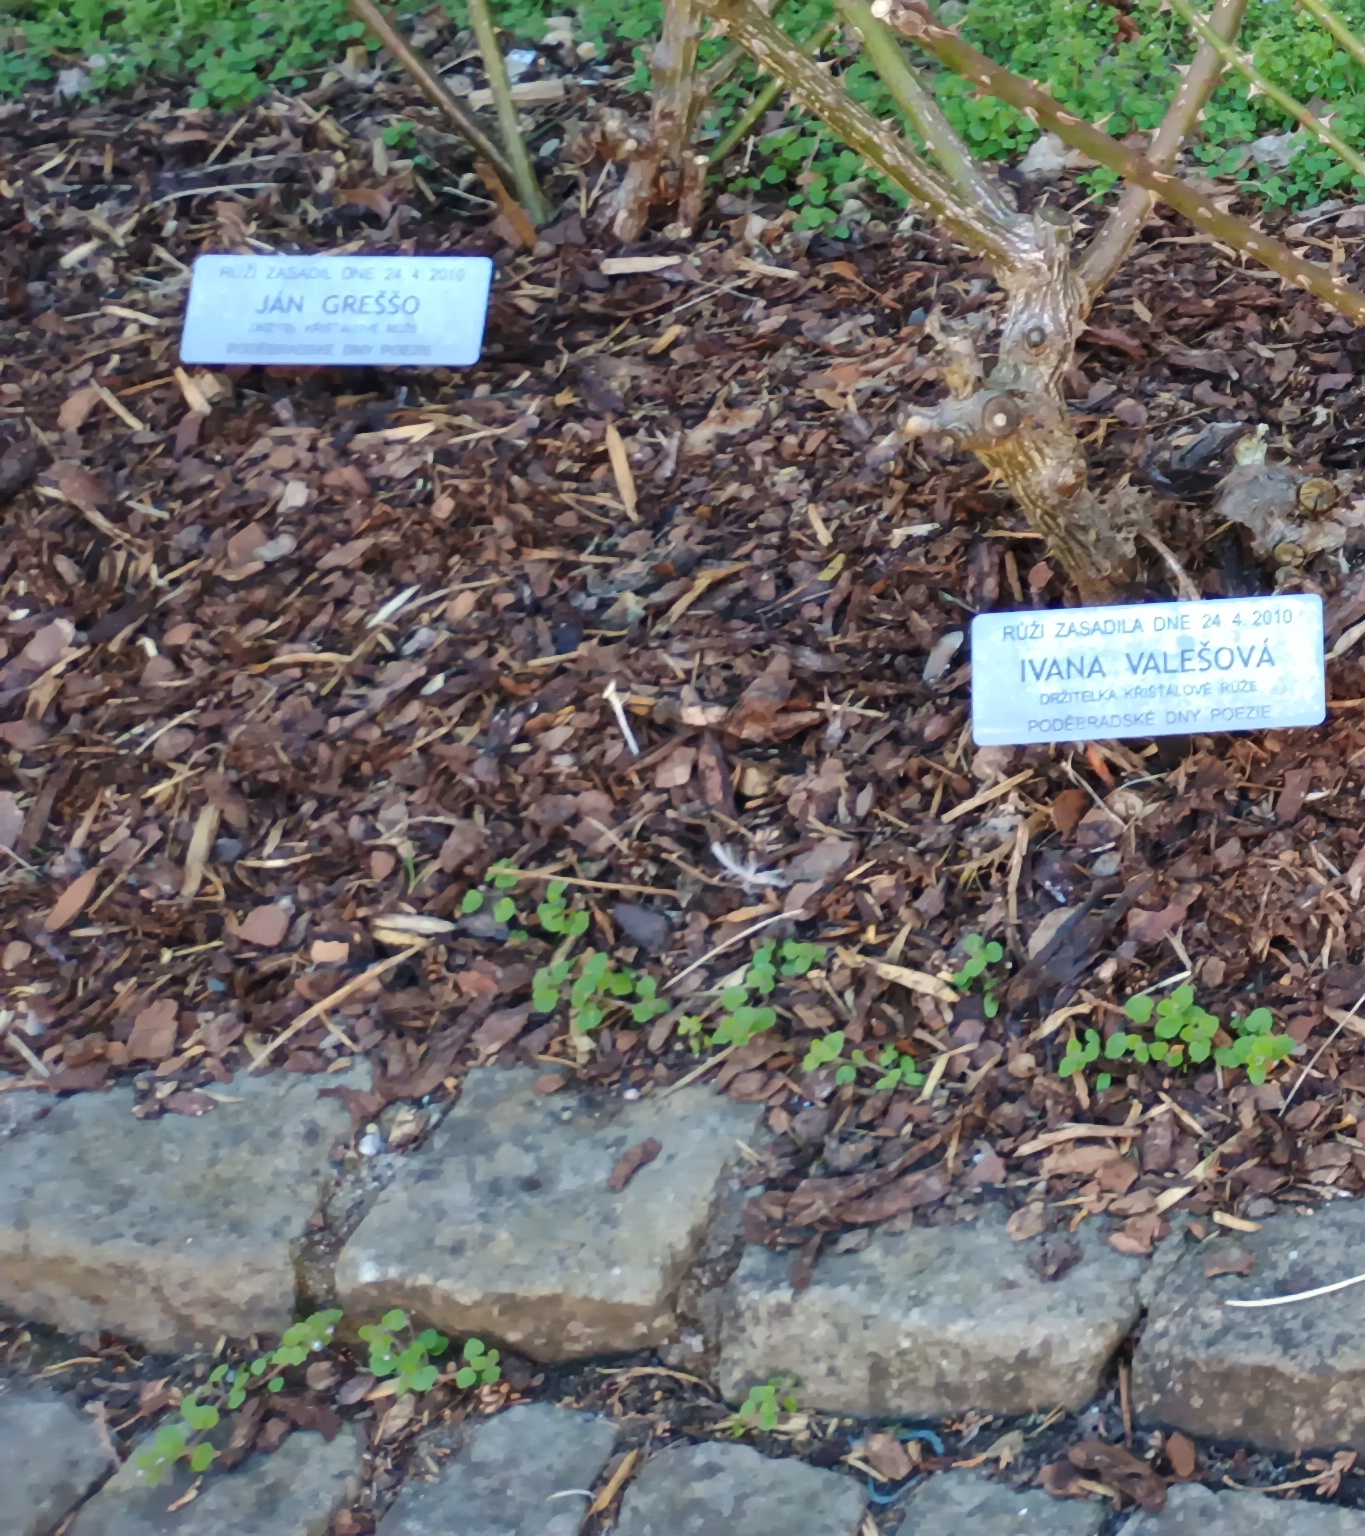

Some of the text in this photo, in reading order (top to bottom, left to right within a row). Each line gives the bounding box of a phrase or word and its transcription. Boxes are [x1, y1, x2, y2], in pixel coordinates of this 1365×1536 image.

[254, 289, 420, 315] JÁN GREŠŠO
[1002, 621, 1044, 640] RŮŽI
[1055, 619, 1144, 637] ZASADILA
[1154, 614, 1190, 631] DNE
[1252, 609, 1293, 626] 2010
[1020, 637, 1275, 682] IVANA VALEŠOVÁ
[1039, 689, 1118, 705] DRŽITELKA
[1027, 704, 1272, 733] PODĚBRADSKÉ DNY POEZIE
